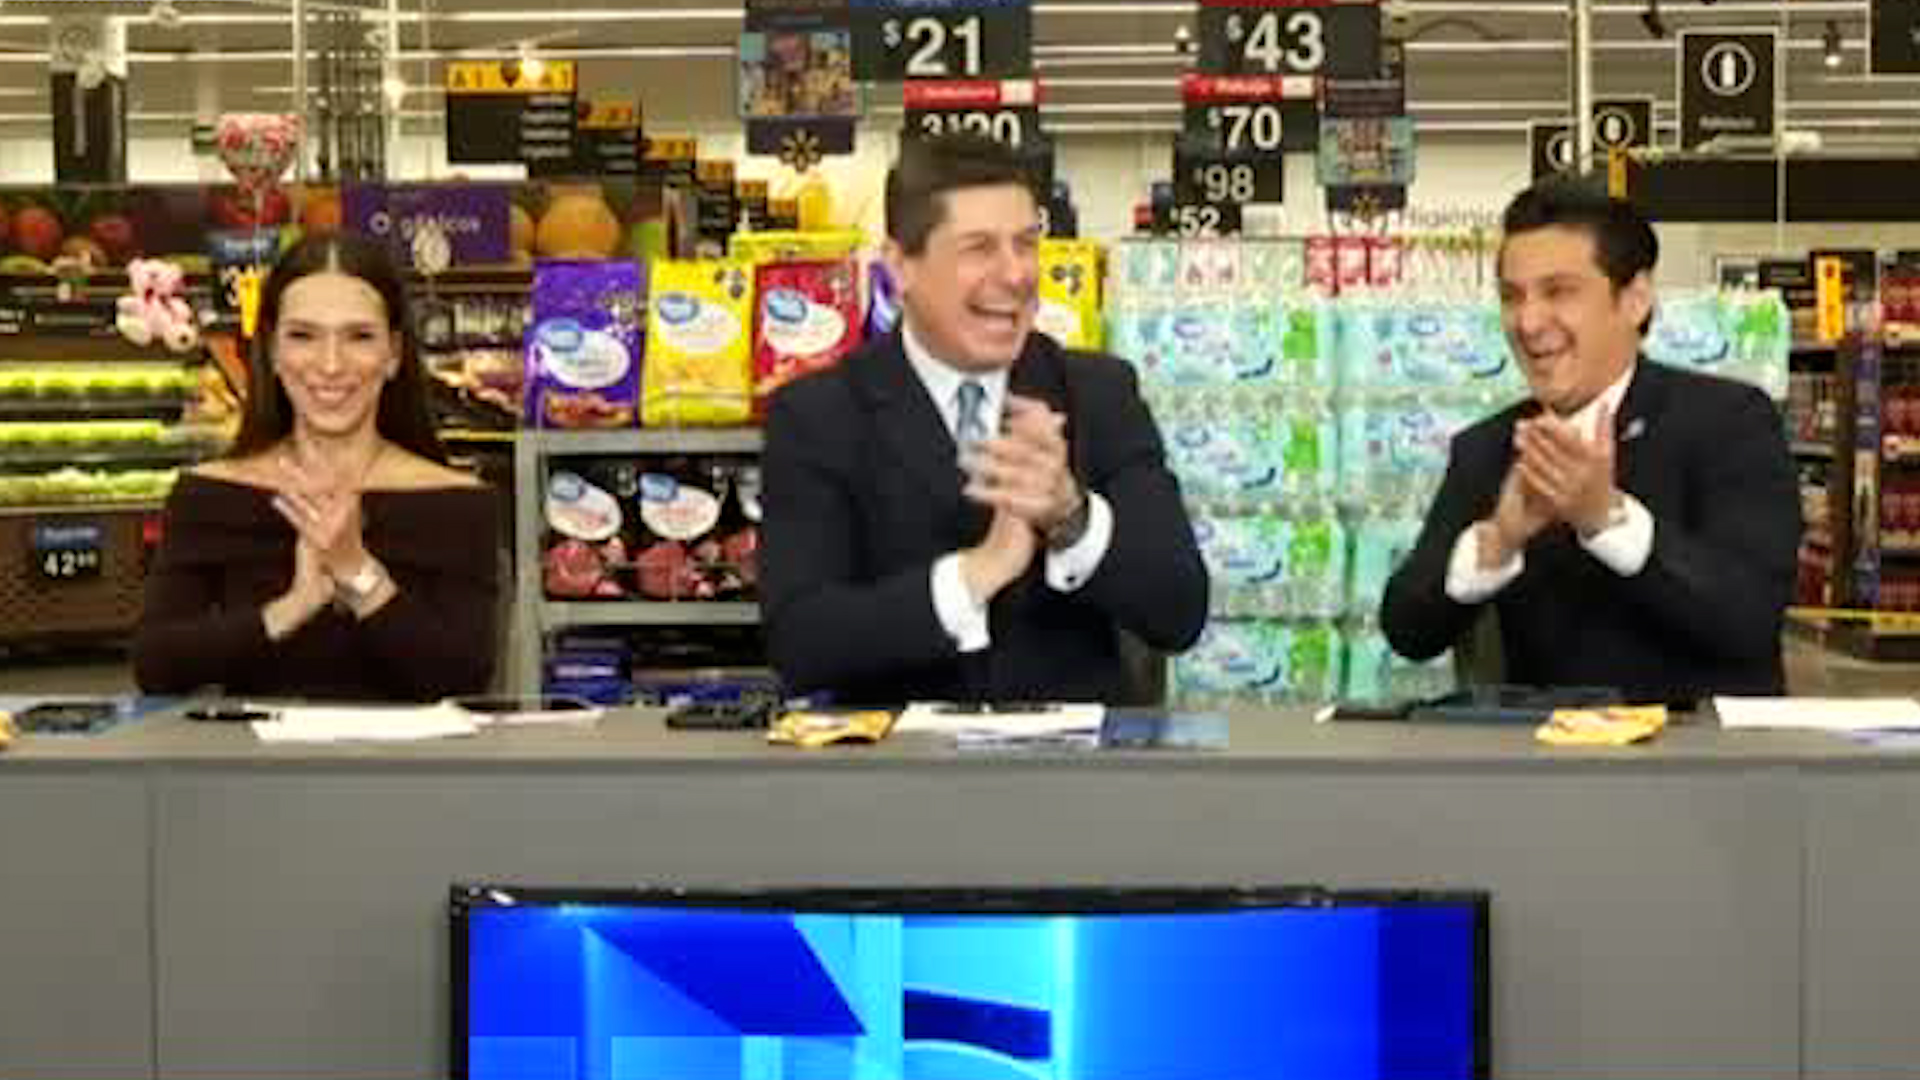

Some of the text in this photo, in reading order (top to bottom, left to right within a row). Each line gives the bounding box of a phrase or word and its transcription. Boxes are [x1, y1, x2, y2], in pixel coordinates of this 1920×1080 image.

[881, 15, 981, 76] $21
[1226, 11, 1325, 72] $43
[1206, 105, 1283, 150] $70
